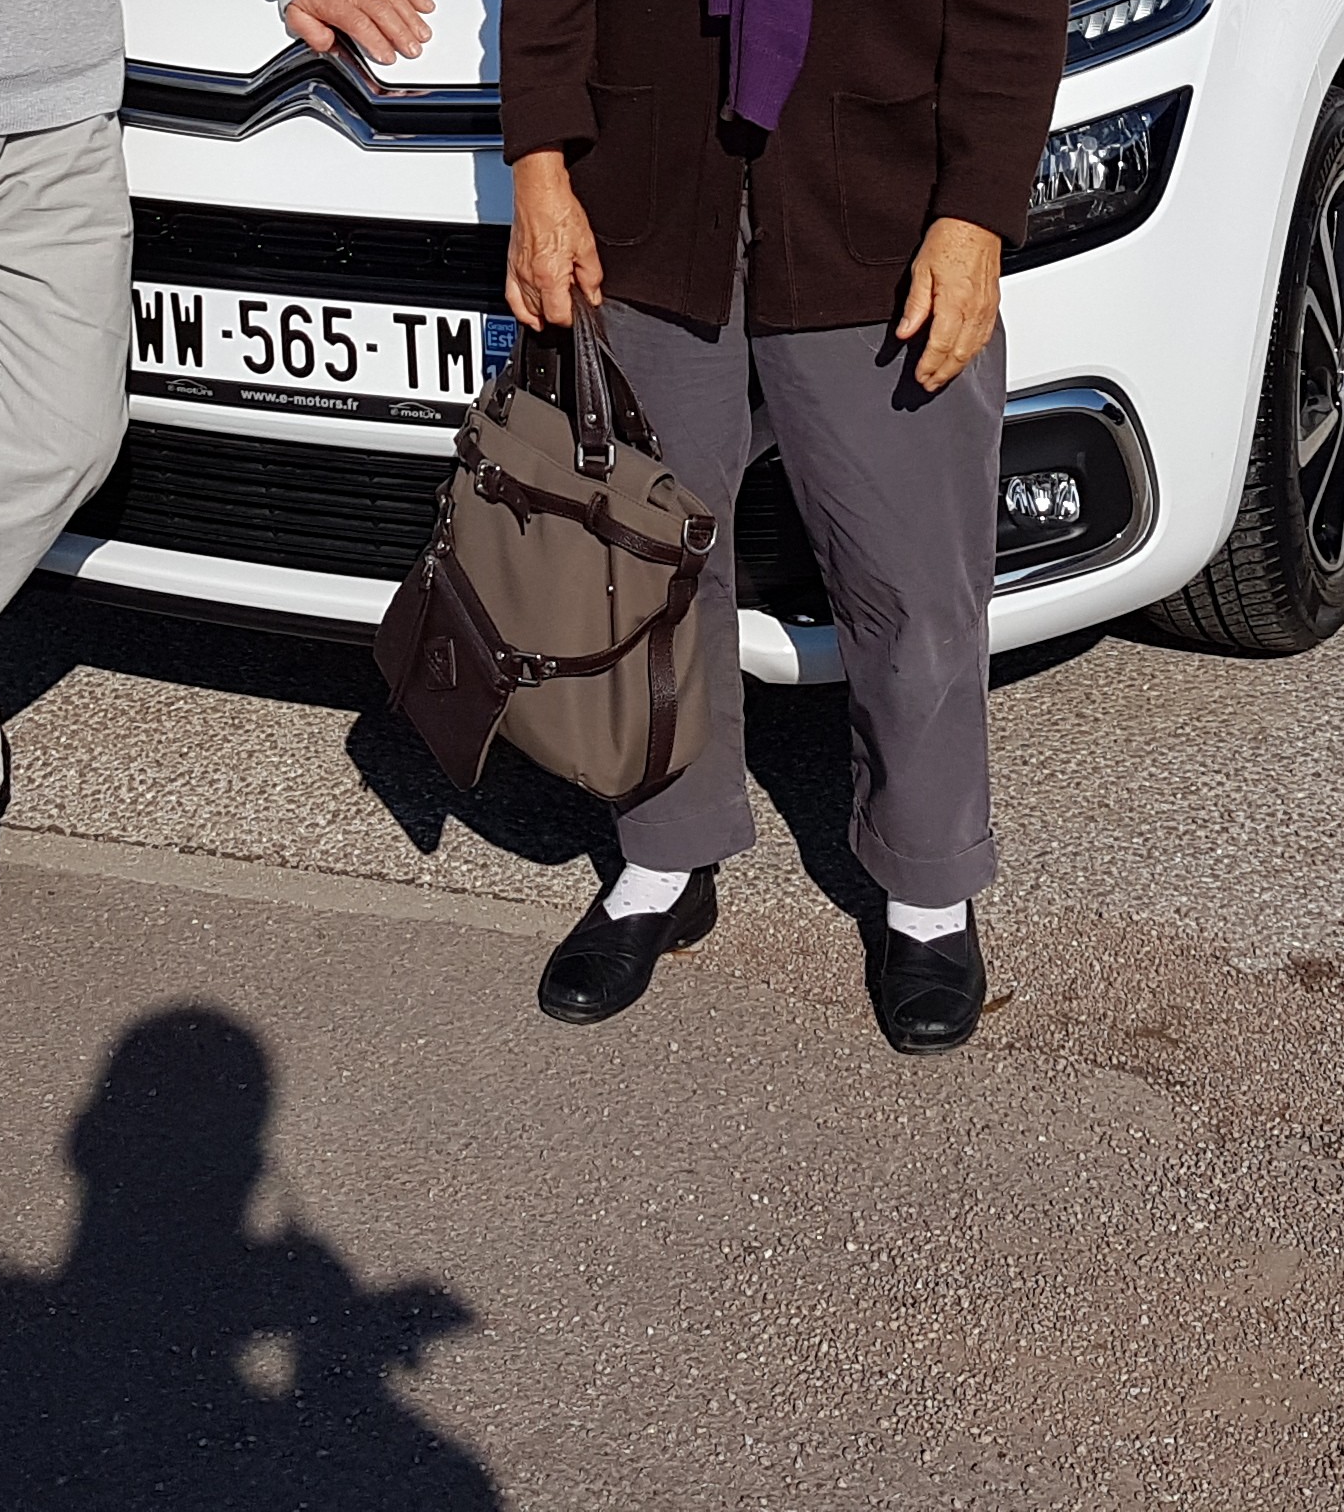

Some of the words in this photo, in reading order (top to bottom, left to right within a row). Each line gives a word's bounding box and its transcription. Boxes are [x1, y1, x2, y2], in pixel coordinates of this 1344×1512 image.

[487, 321, 514, 332] Grand
[487, 330, 514, 348] Est
[240, 389, 359, 411] www.e-motors.fr
